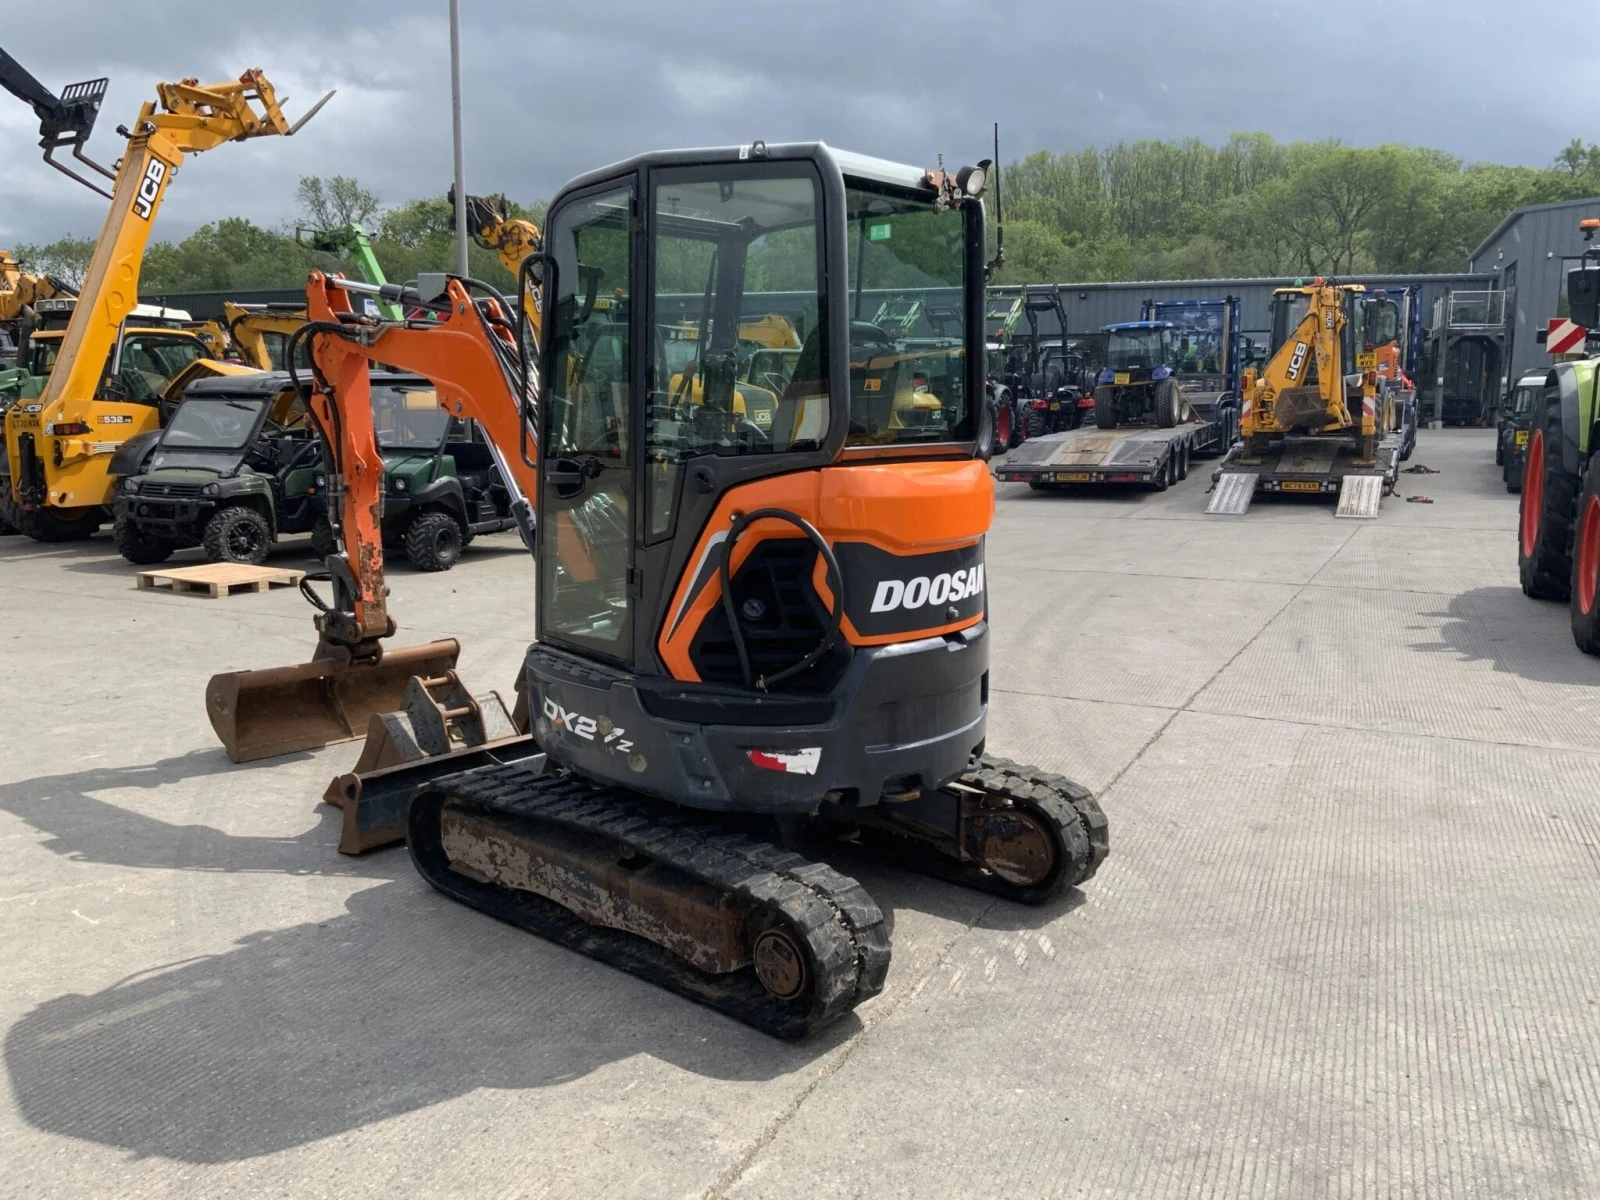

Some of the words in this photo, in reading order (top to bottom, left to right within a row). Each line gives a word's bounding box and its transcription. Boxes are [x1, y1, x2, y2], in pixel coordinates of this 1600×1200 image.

[136, 158, 166, 219] JCB
[1288, 342, 1307, 380] JCB
[23, 404, 42, 412] JCB
[755, 412, 770, 421] JCB
[869, 562, 985, 613] DOOSAN
